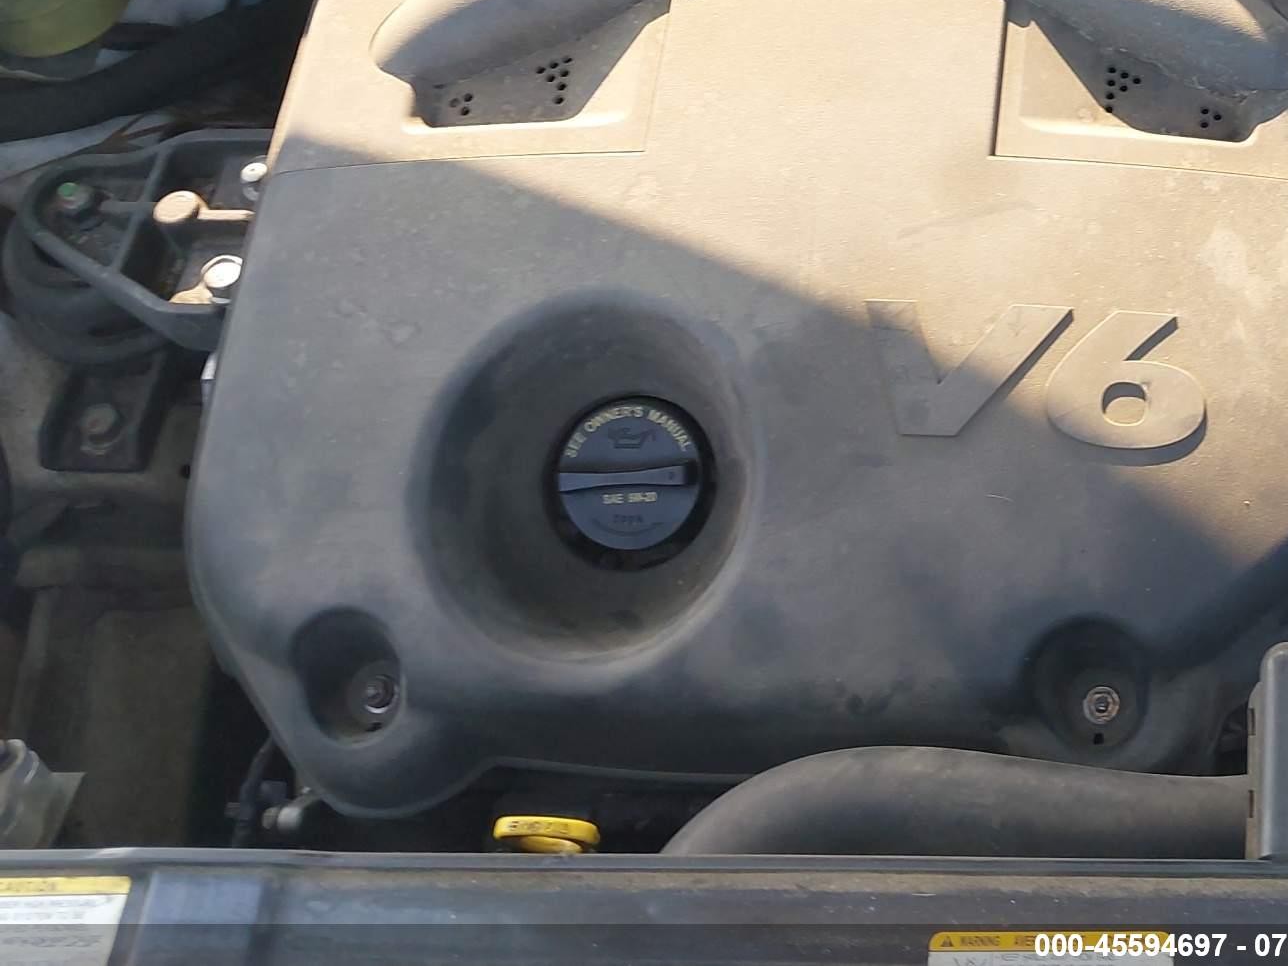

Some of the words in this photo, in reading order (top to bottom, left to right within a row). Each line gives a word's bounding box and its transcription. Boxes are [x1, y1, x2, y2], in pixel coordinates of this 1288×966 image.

[863, 298, 1207, 450] V6
[565, 433, 586, 459] SEE
[647, 409, 692, 452] MANUAL
[602, 493, 624, 504] SAE
